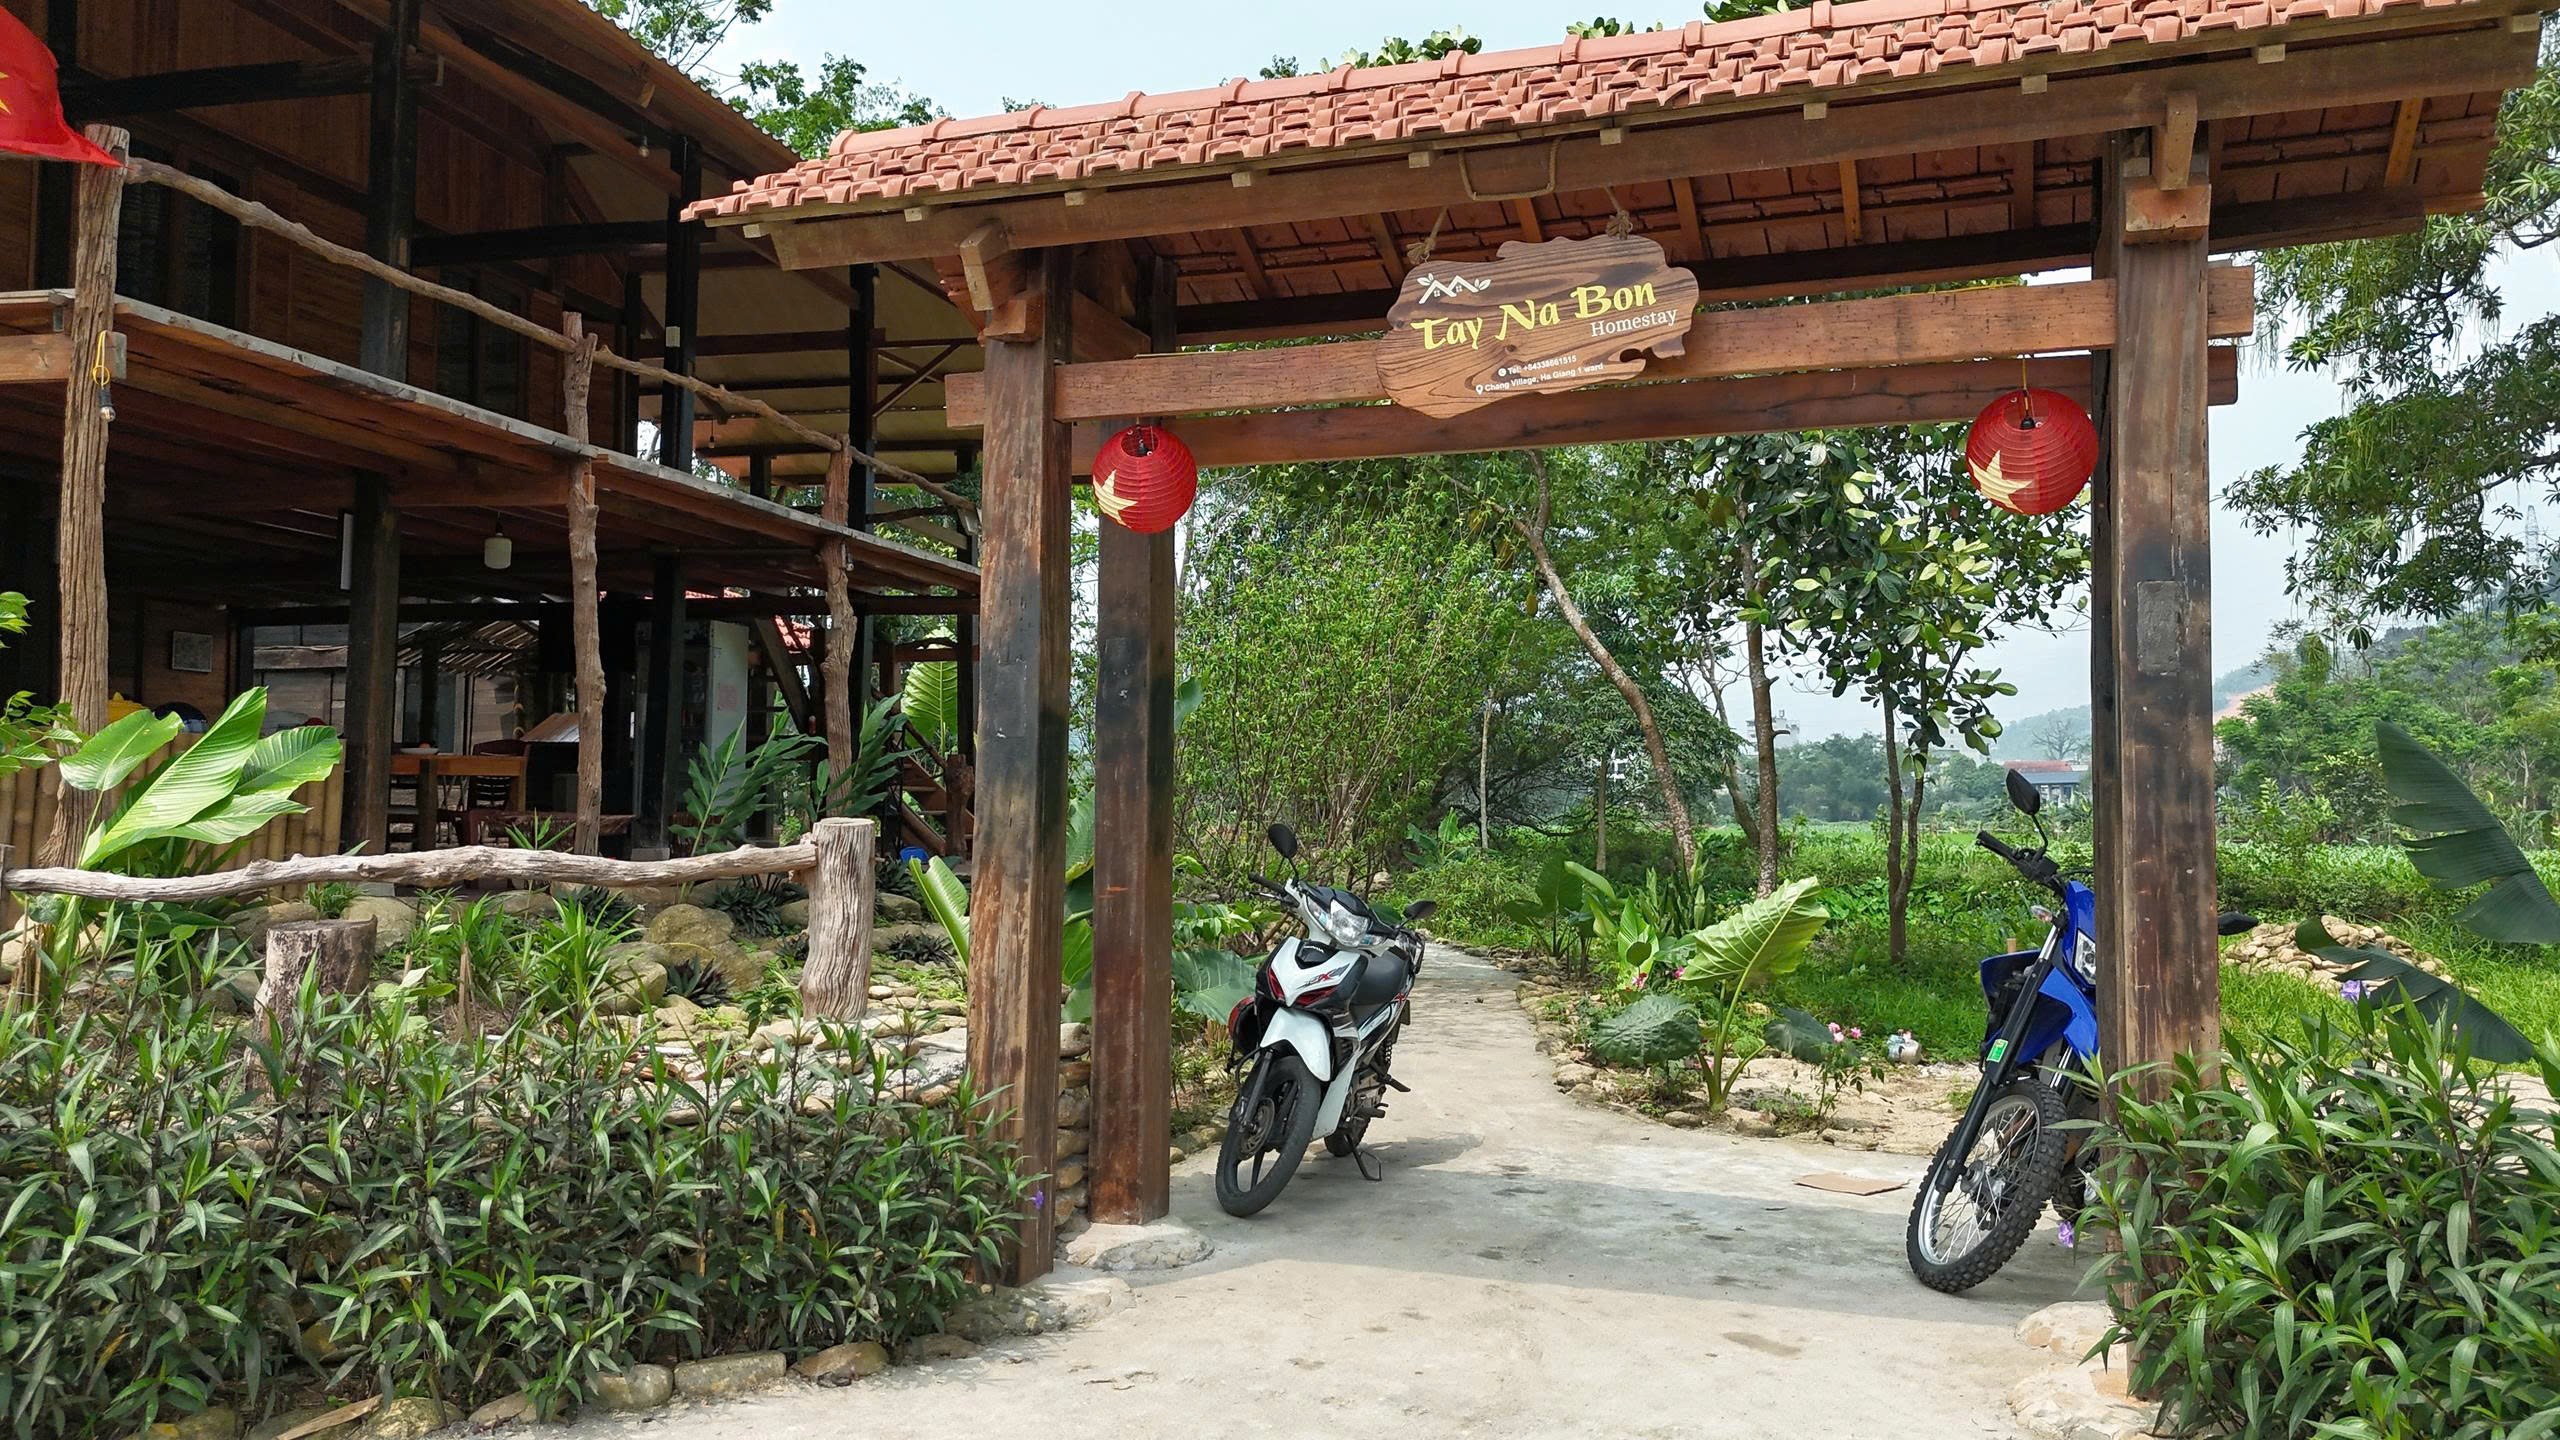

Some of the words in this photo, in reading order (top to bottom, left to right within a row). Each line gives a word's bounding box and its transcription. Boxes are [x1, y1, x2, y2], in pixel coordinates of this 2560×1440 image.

[1410, 317, 1483, 350] Tay
[1494, 299, 1561, 341] Na
[1569, 282, 1657, 319] Bon
[1590, 308, 1678, 337] Homestay
[1484, 382, 1510, 392] Chang
[1540, 373, 1552, 381] Ha
[1552, 368, 1576, 379] Giang
[1577, 366, 1582, 374] 1
[1583, 363, 1604, 373] ward
[1507, 365, 1522, 375] Tel:
